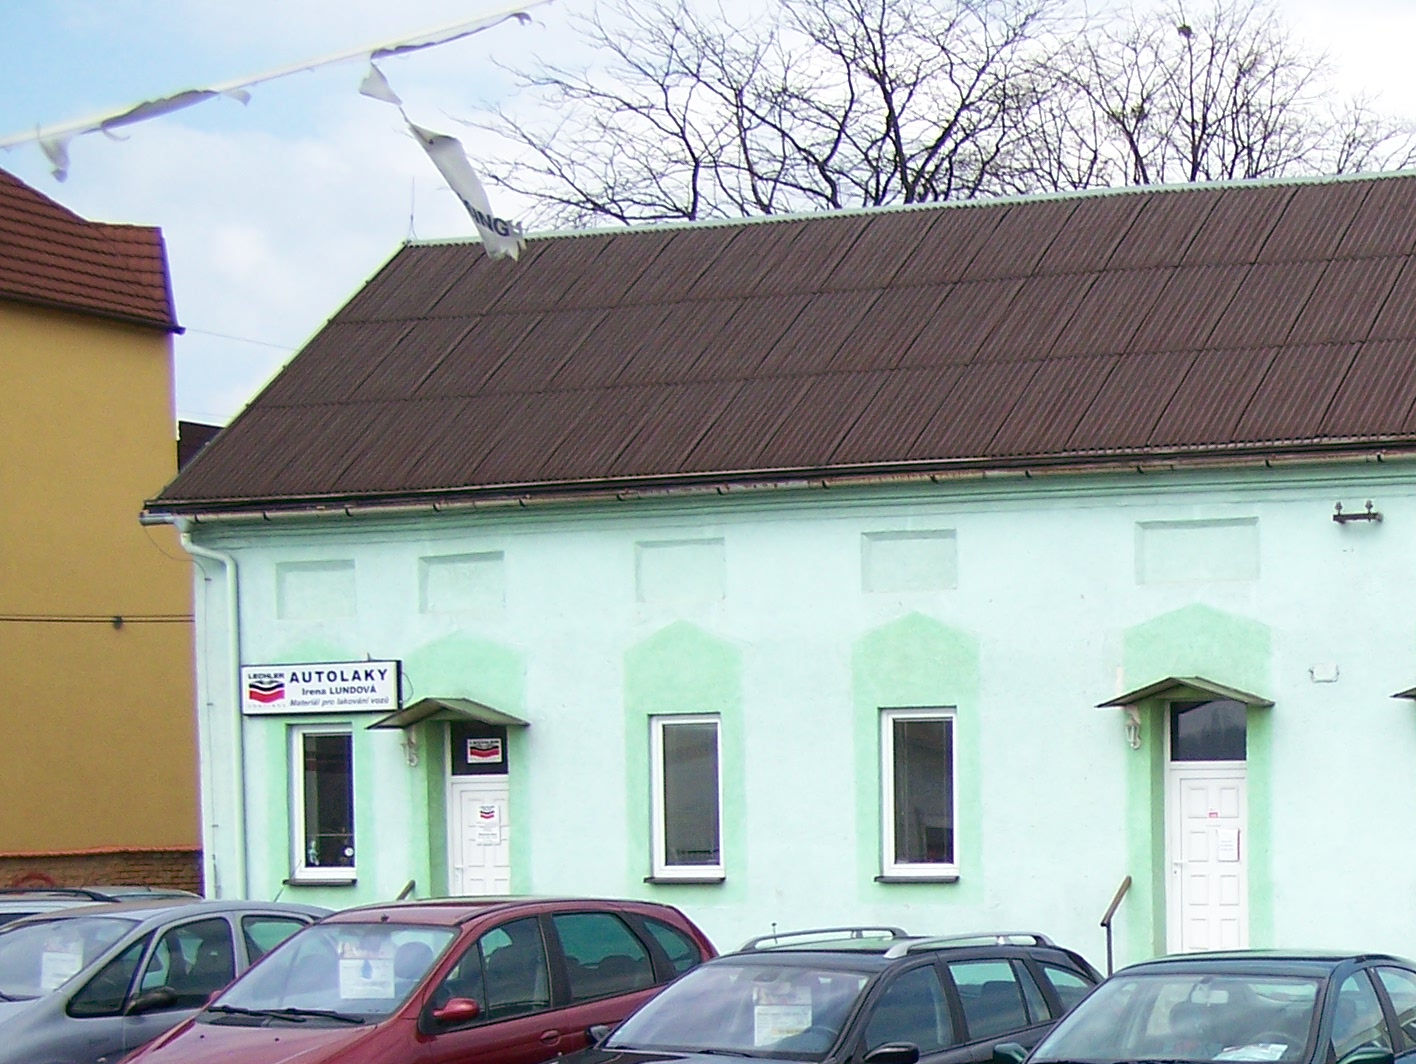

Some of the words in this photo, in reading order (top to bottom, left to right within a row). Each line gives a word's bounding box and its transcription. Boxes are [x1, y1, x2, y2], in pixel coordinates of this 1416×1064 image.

[289, 669, 388, 684] AUTOLAKY
[302, 688, 327, 696] Irena
[330, 685, 377, 695] LUNDOVÁ
[321, 699, 334, 708] pro
